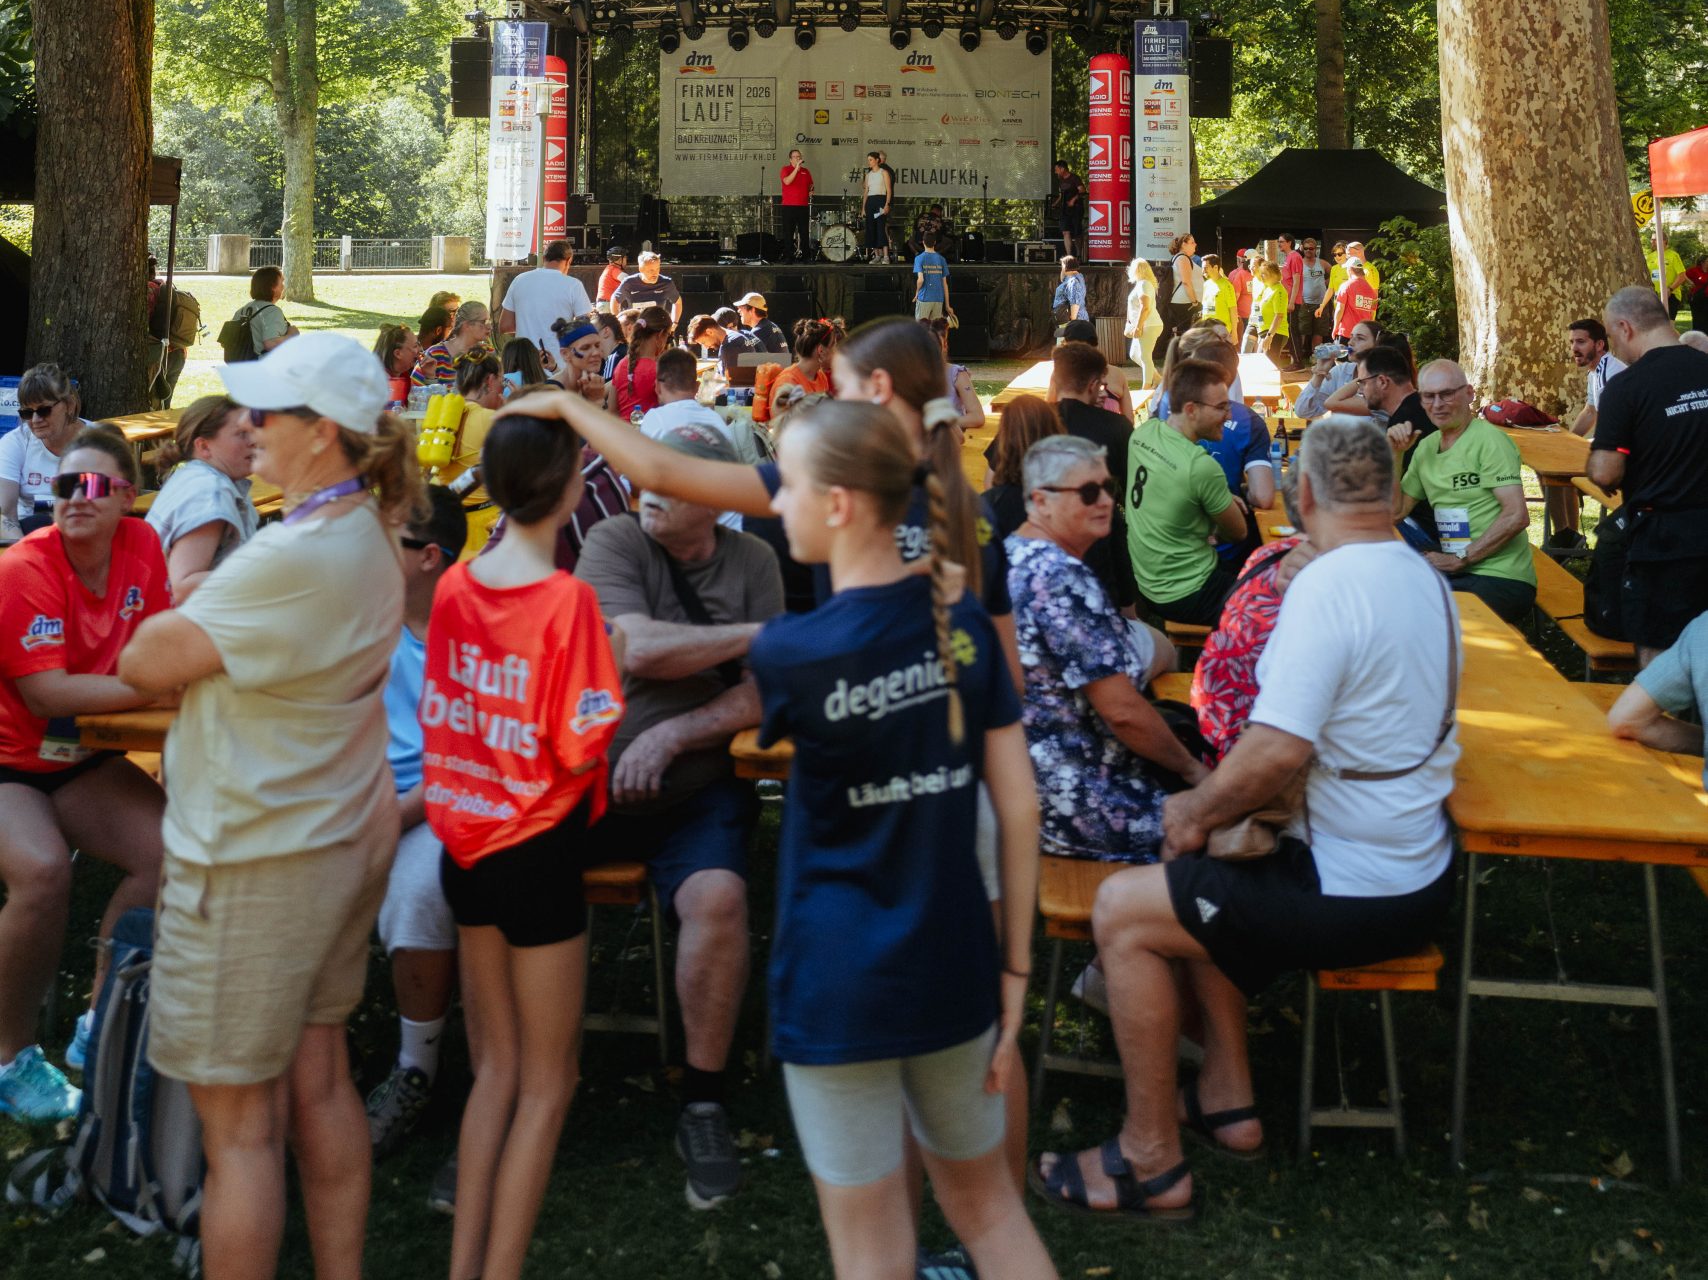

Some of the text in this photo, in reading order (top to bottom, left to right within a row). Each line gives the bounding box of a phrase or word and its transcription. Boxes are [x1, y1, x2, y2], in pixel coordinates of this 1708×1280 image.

[1144, 44, 1166, 53] LAUF
[685, 50, 713, 66] dm
[906, 50, 932, 66] dm
[682, 84, 734, 98] FIRMEN
[746, 86, 771, 98] 2026
[1154, 79, 1173, 90] dm
[868, 90, 891, 98] 88.3
[975, 89, 1040, 99] BIONTECH
[682, 101, 734, 122] LAUF
[677, 134, 738, 144] BAD KREUZNACH
[1664, 402, 1690, 417] NICHT
[1131, 465, 1148, 510] 8
[1453, 472, 1481, 489] FSG
[31, 617, 62, 636] dm
[448, 638, 531, 704] Läuft
[420, 679, 477, 736] bei
[577, 688, 613, 717] dm
[848, 776, 912, 808] Läuft
[911, 766, 948, 796] bei
